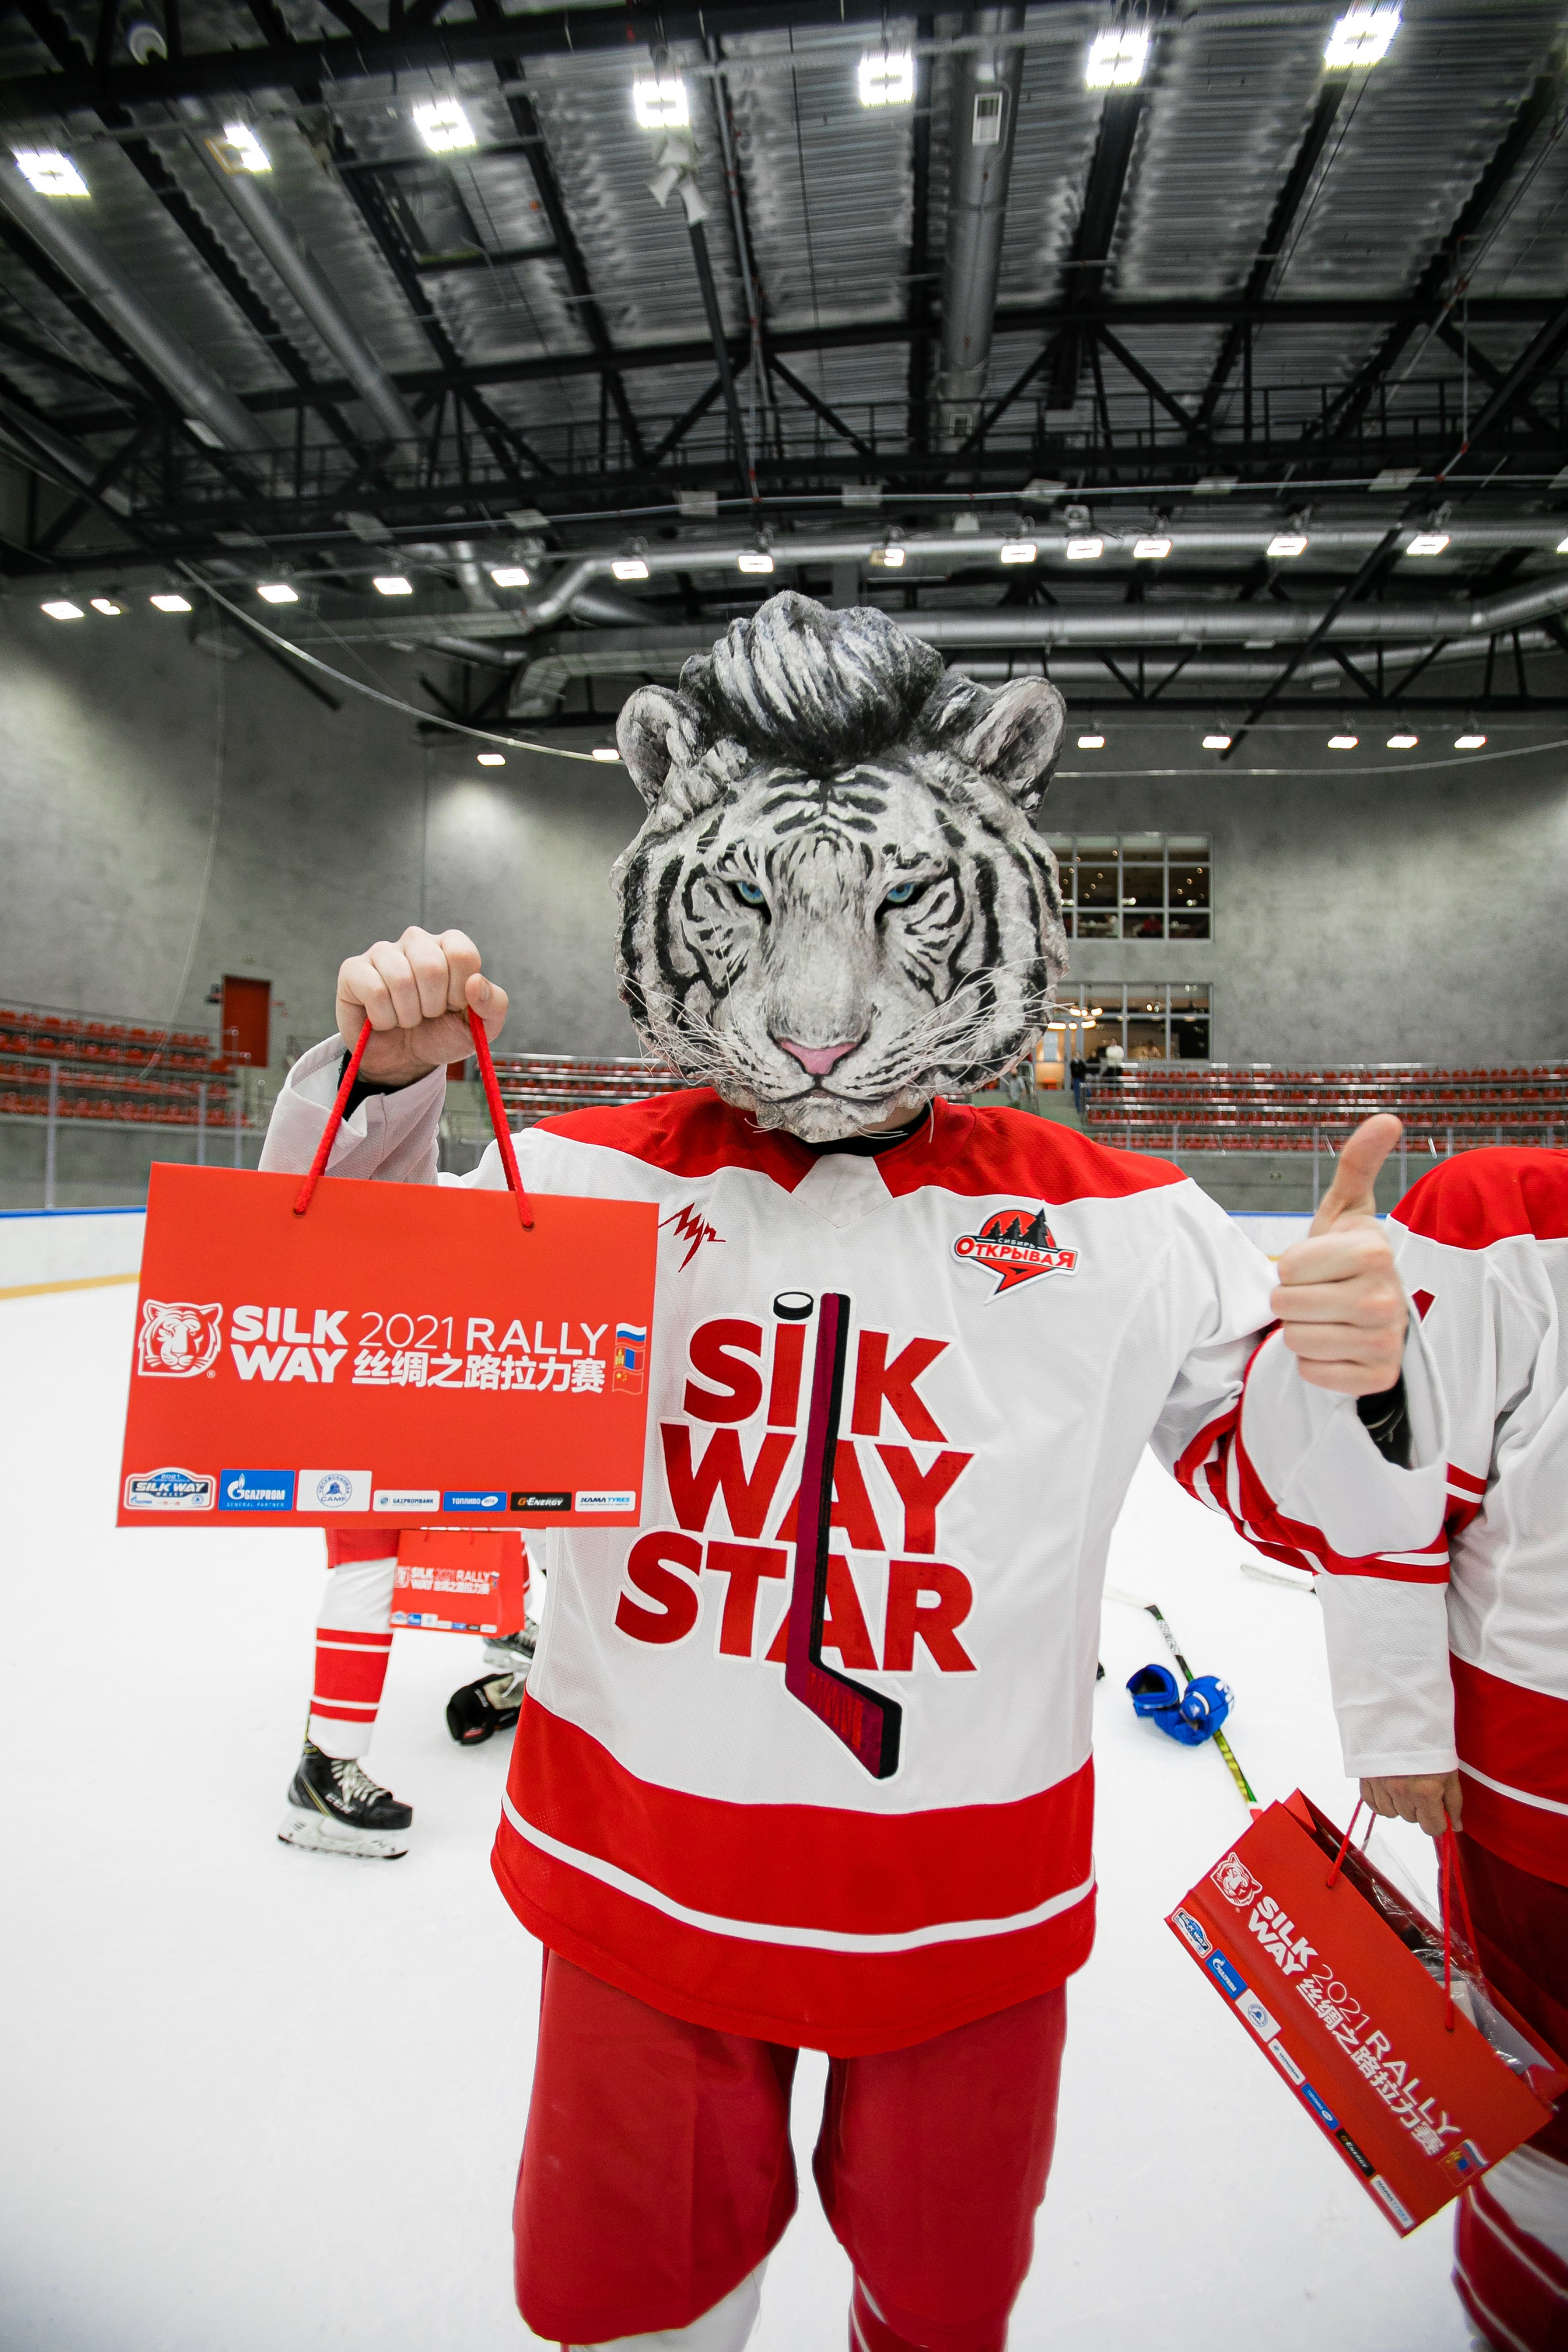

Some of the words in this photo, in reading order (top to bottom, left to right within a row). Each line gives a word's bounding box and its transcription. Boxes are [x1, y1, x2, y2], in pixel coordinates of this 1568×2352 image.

[956, 1236, 1076, 1268] ОТКРЫВАЯ
[997, 1237, 1036, 1249] СИБИРЬ
[231, 1305, 349, 1346] SILK
[359, 1311, 454, 1350] 2021
[466, 1319, 609, 1356] RALLY
[231, 1343, 347, 1383] WAY
[352, 1348, 606, 1393] 丝绸之路拉力赛
[135, 1482, 172, 1492] SILK
[173, 1483, 205, 1493] WAY
[244, 1489, 285, 1501] GAZPROM
[660, 1423, 974, 1555] WAY
[410, 1566, 435, 1579] SILK
[456, 1569, 491, 1583] RALLY
[614, 1530, 979, 1673] STAR
[1248, 1908, 1306, 1975] WAY
[1257, 1896, 1319, 1969] SILK
[1296, 1978, 1446, 2156] 丝绸之路拉力赛
[1311, 1964, 1371, 2030] 2021
[1365, 2029, 1462, 2136] RALLY
